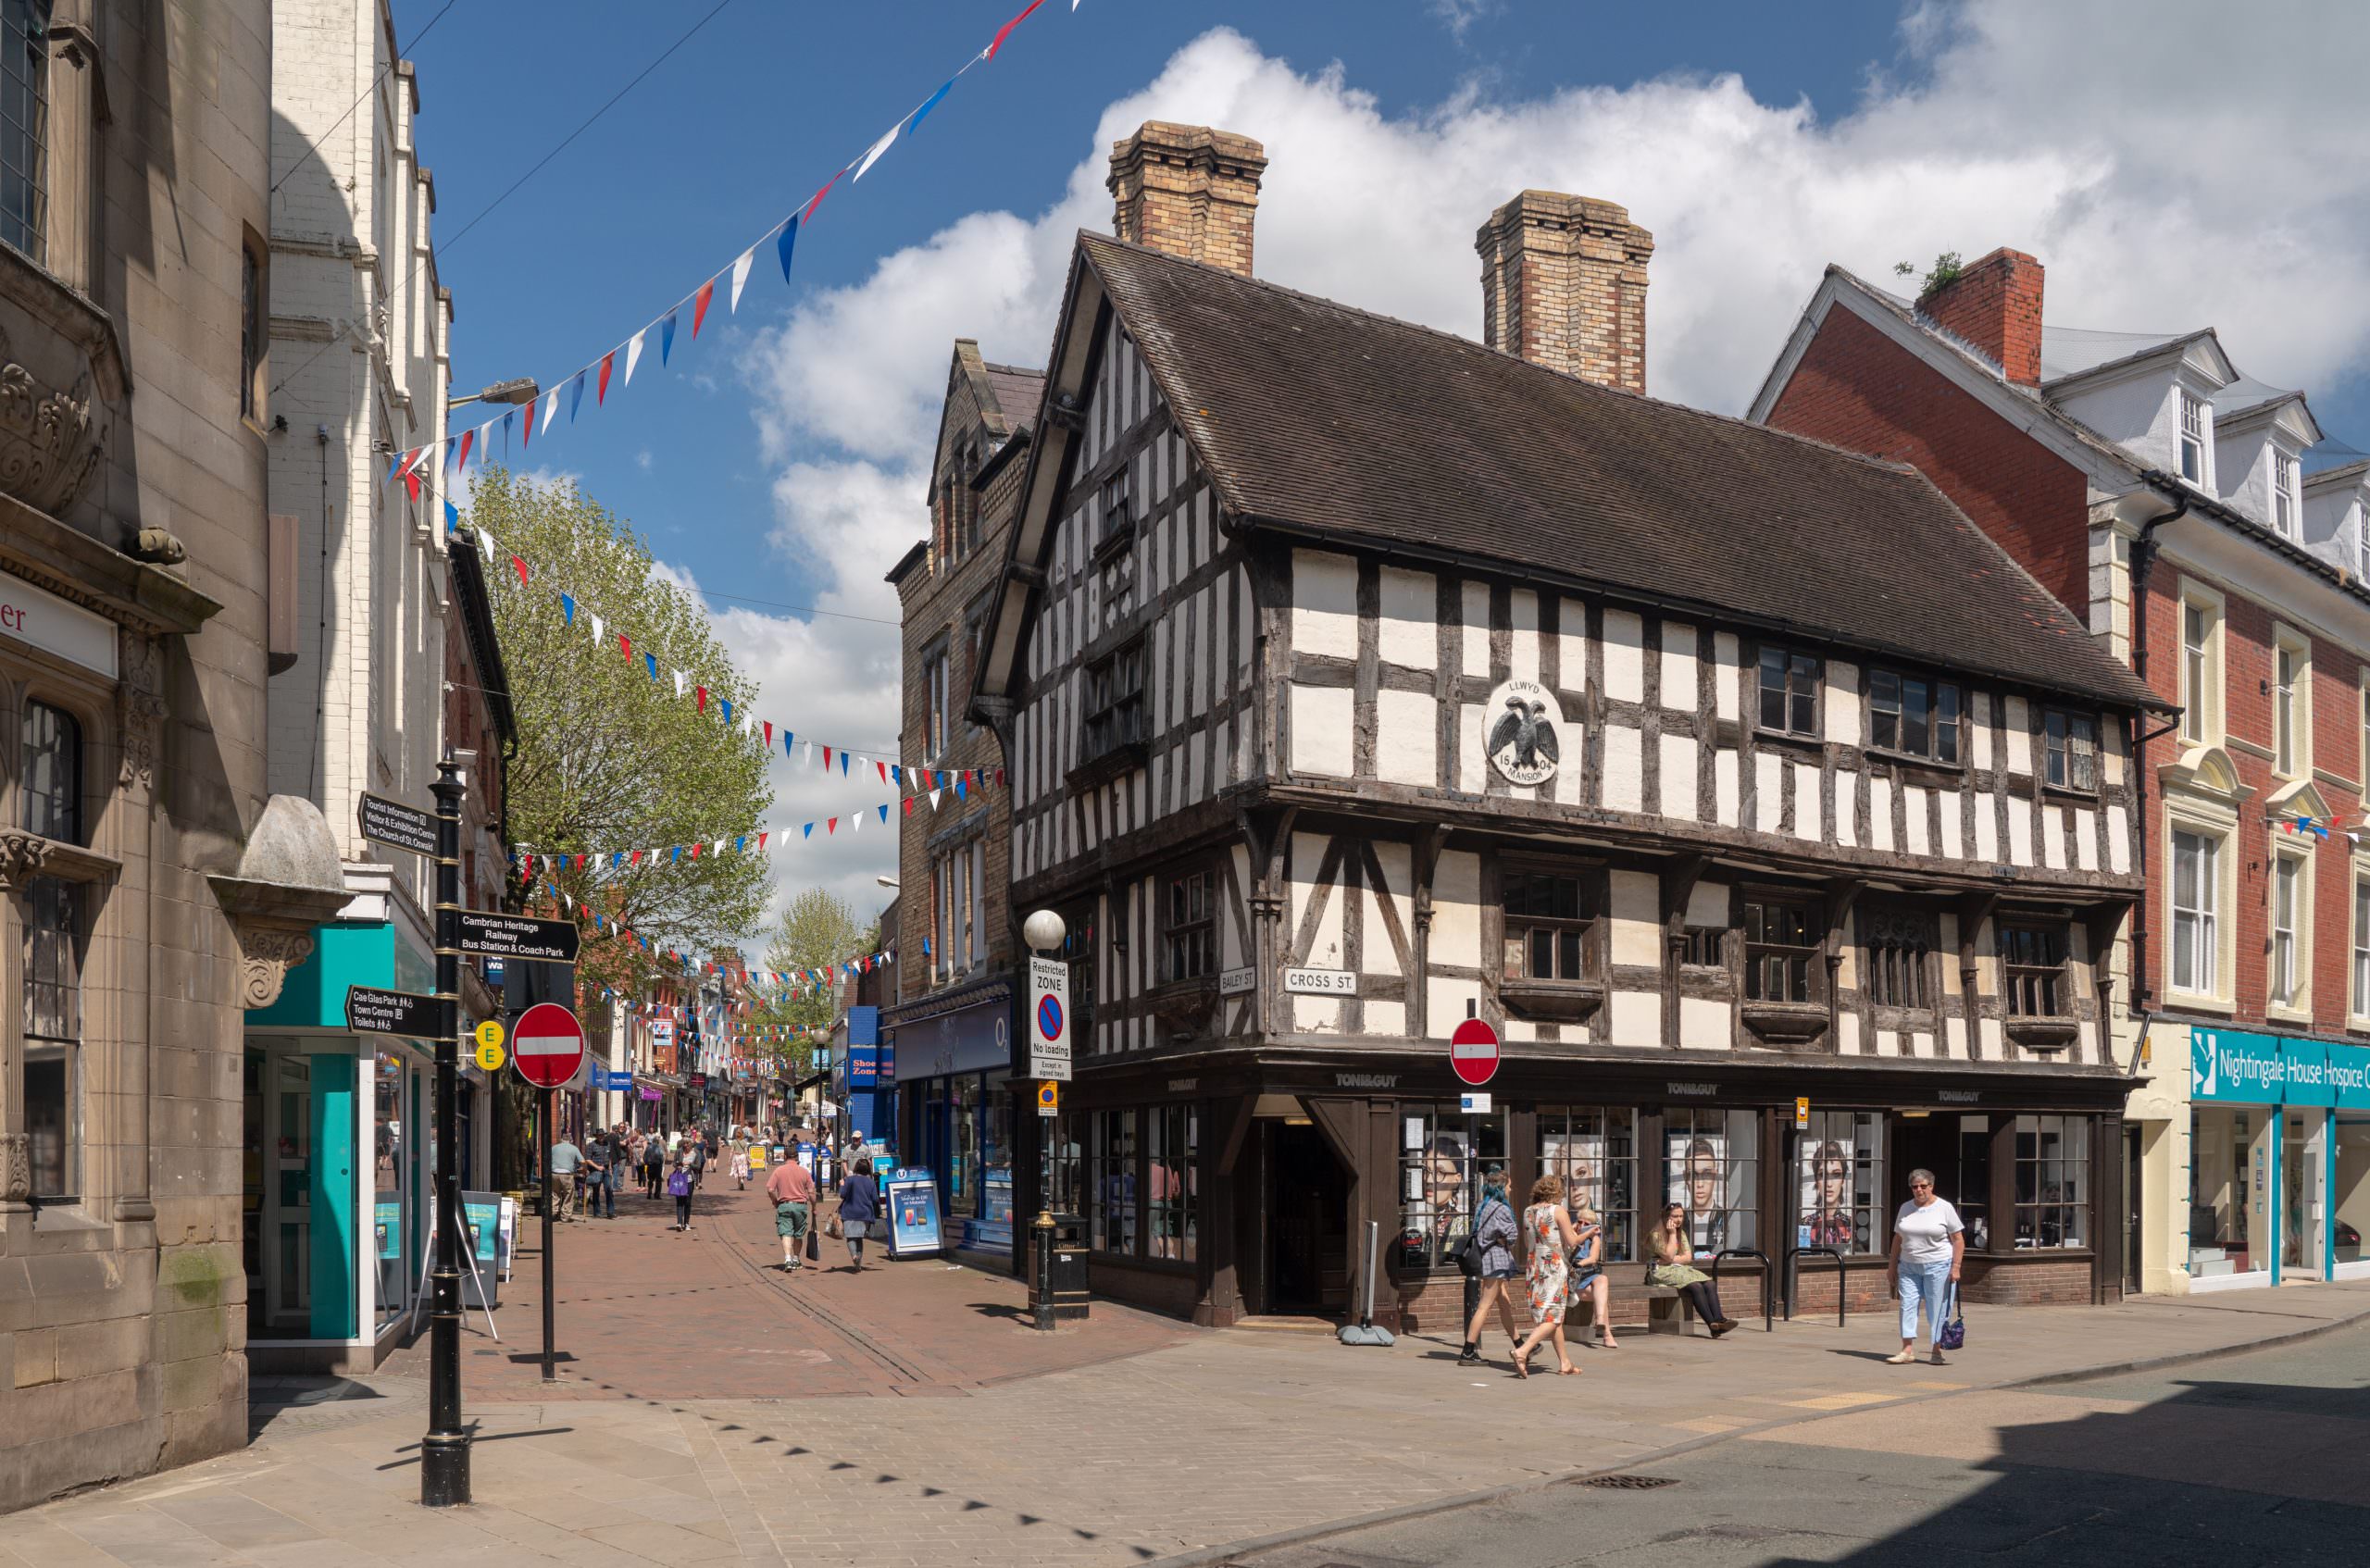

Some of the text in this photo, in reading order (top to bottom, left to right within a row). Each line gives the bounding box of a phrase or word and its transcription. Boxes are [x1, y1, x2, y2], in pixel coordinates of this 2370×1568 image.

[1508, 680, 1540, 694] LLWYD
[1506, 767, 1543, 781] MANSION
[366, 798, 386, 814] Tourist
[387, 805, 418, 824] Information
[366, 811, 436, 840] Visitor & Exhibition Centre
[366, 824, 378, 836] The
[379, 828, 399, 842] Church
[400, 834, 405, 843] of
[413, 839, 433, 852] Oswald
[463, 915, 539, 933] Cambrian Heritage
[485, 929, 518, 942] Railway
[462, 940, 564, 957] Bus Station & Coach Park
[1032, 961, 1066, 977] Restricted
[1037, 976, 1062, 991] ZONE
[1222, 975, 1243, 989] BAILEY
[1290, 973, 1352, 989] CROSS ST.
[353, 990, 397, 1006] Cae Glas Park
[353, 1004, 371, 1015] Town
[371, 1006, 393, 1017] Centre
[353, 1016, 376, 1028] Toilets
[1033, 1042, 1069, 1057] No loading
[853, 1059, 877, 1067] Shoe
[2220, 1048, 2285, 1089] Nightingale
[2287, 1055, 2322, 1084] House
[2324, 1058, 2364, 1094] Hospice
